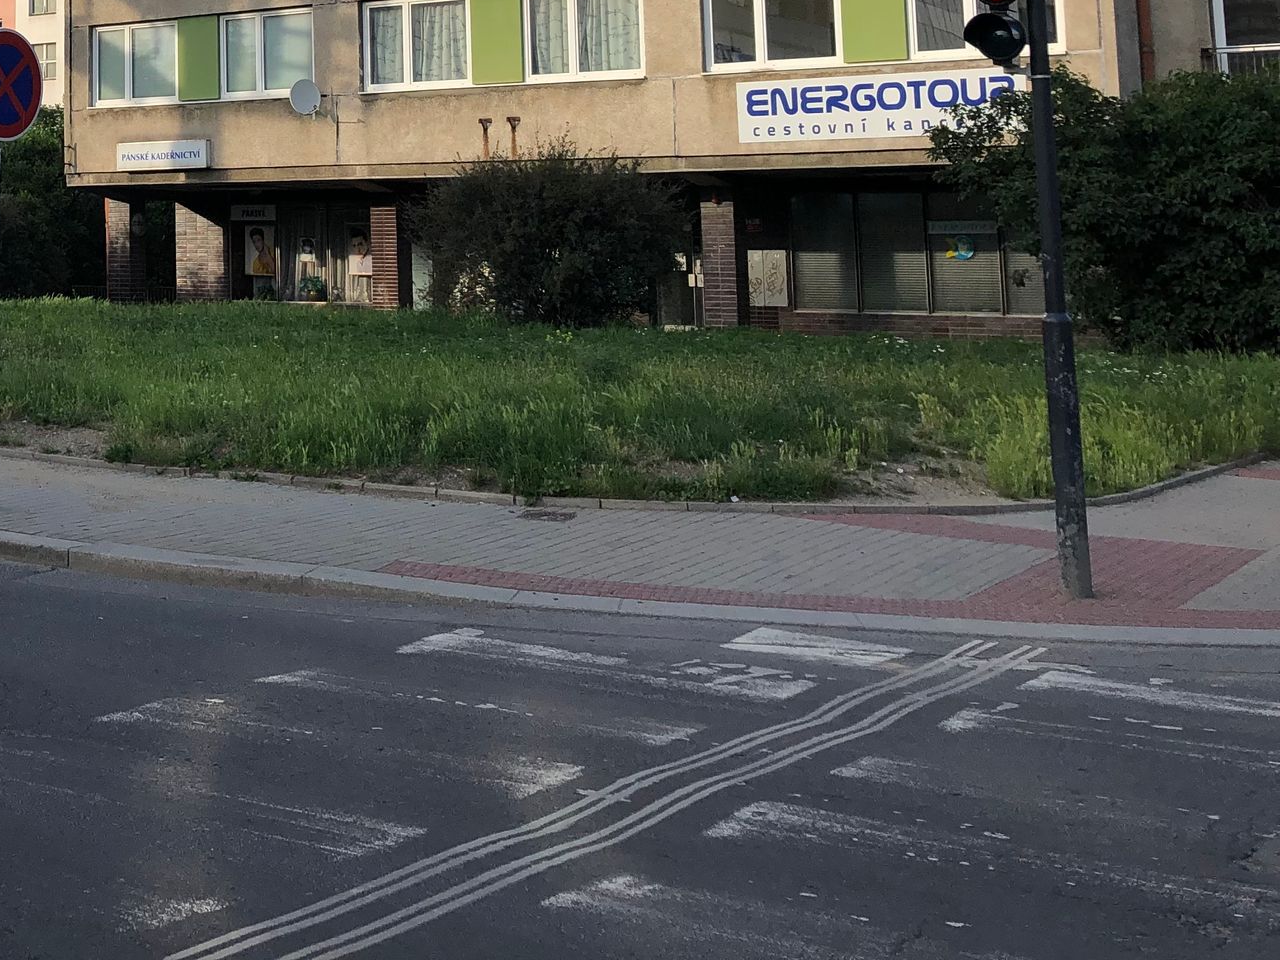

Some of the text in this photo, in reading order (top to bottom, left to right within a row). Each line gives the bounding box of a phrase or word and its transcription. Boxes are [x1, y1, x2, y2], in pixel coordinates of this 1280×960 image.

[745, 75, 1016, 117] ENERGOTOUR
[752, 118, 867, 138] cestovní
[121, 148, 201, 162] PÁNSKÉ KADEŘNICTVÍ
